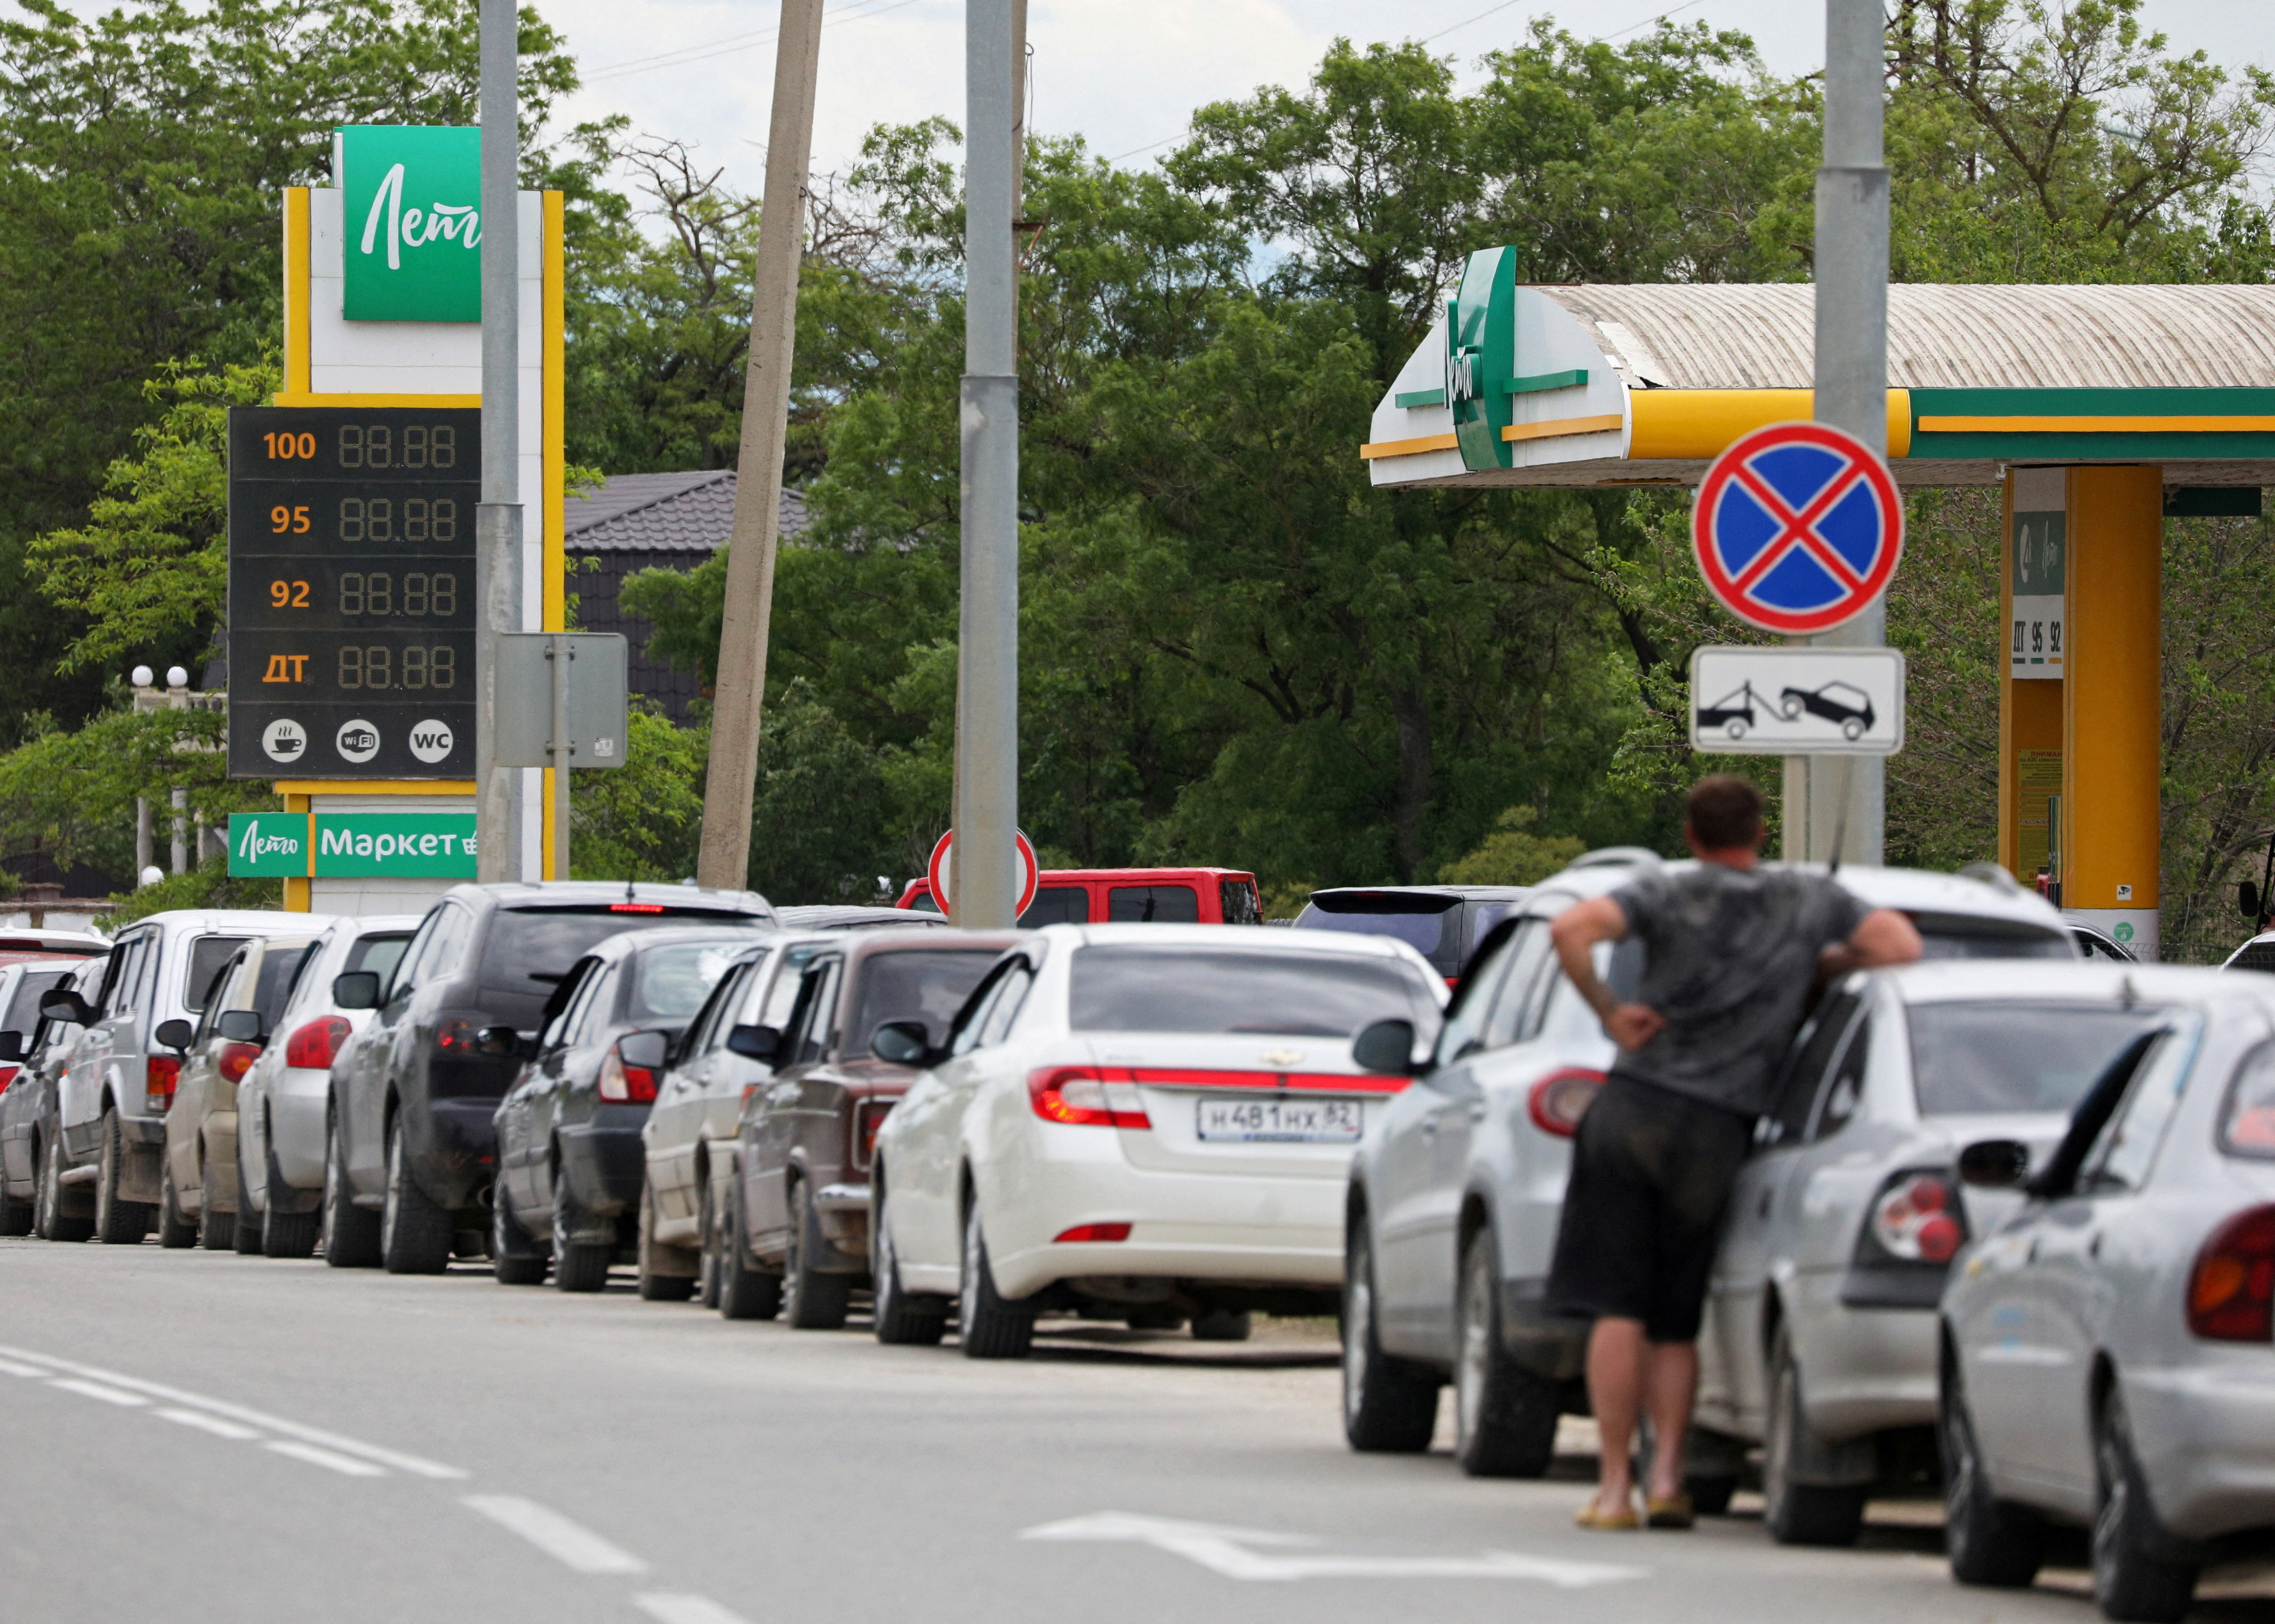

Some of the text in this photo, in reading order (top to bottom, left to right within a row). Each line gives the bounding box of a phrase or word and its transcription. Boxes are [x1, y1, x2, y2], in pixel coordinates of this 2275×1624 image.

[361, 163, 481, 270] Лет
[263, 432, 316, 459] 100
[271, 506, 310, 533] 95
[270, 580, 310, 608] 92
[2013, 621, 2060, 652] ДТ 95 92
[262, 655, 309, 683] ДТ
[414, 733, 449, 748] WC
[239, 820, 298, 864] Лето
[321, 828, 457, 862] Маркет
